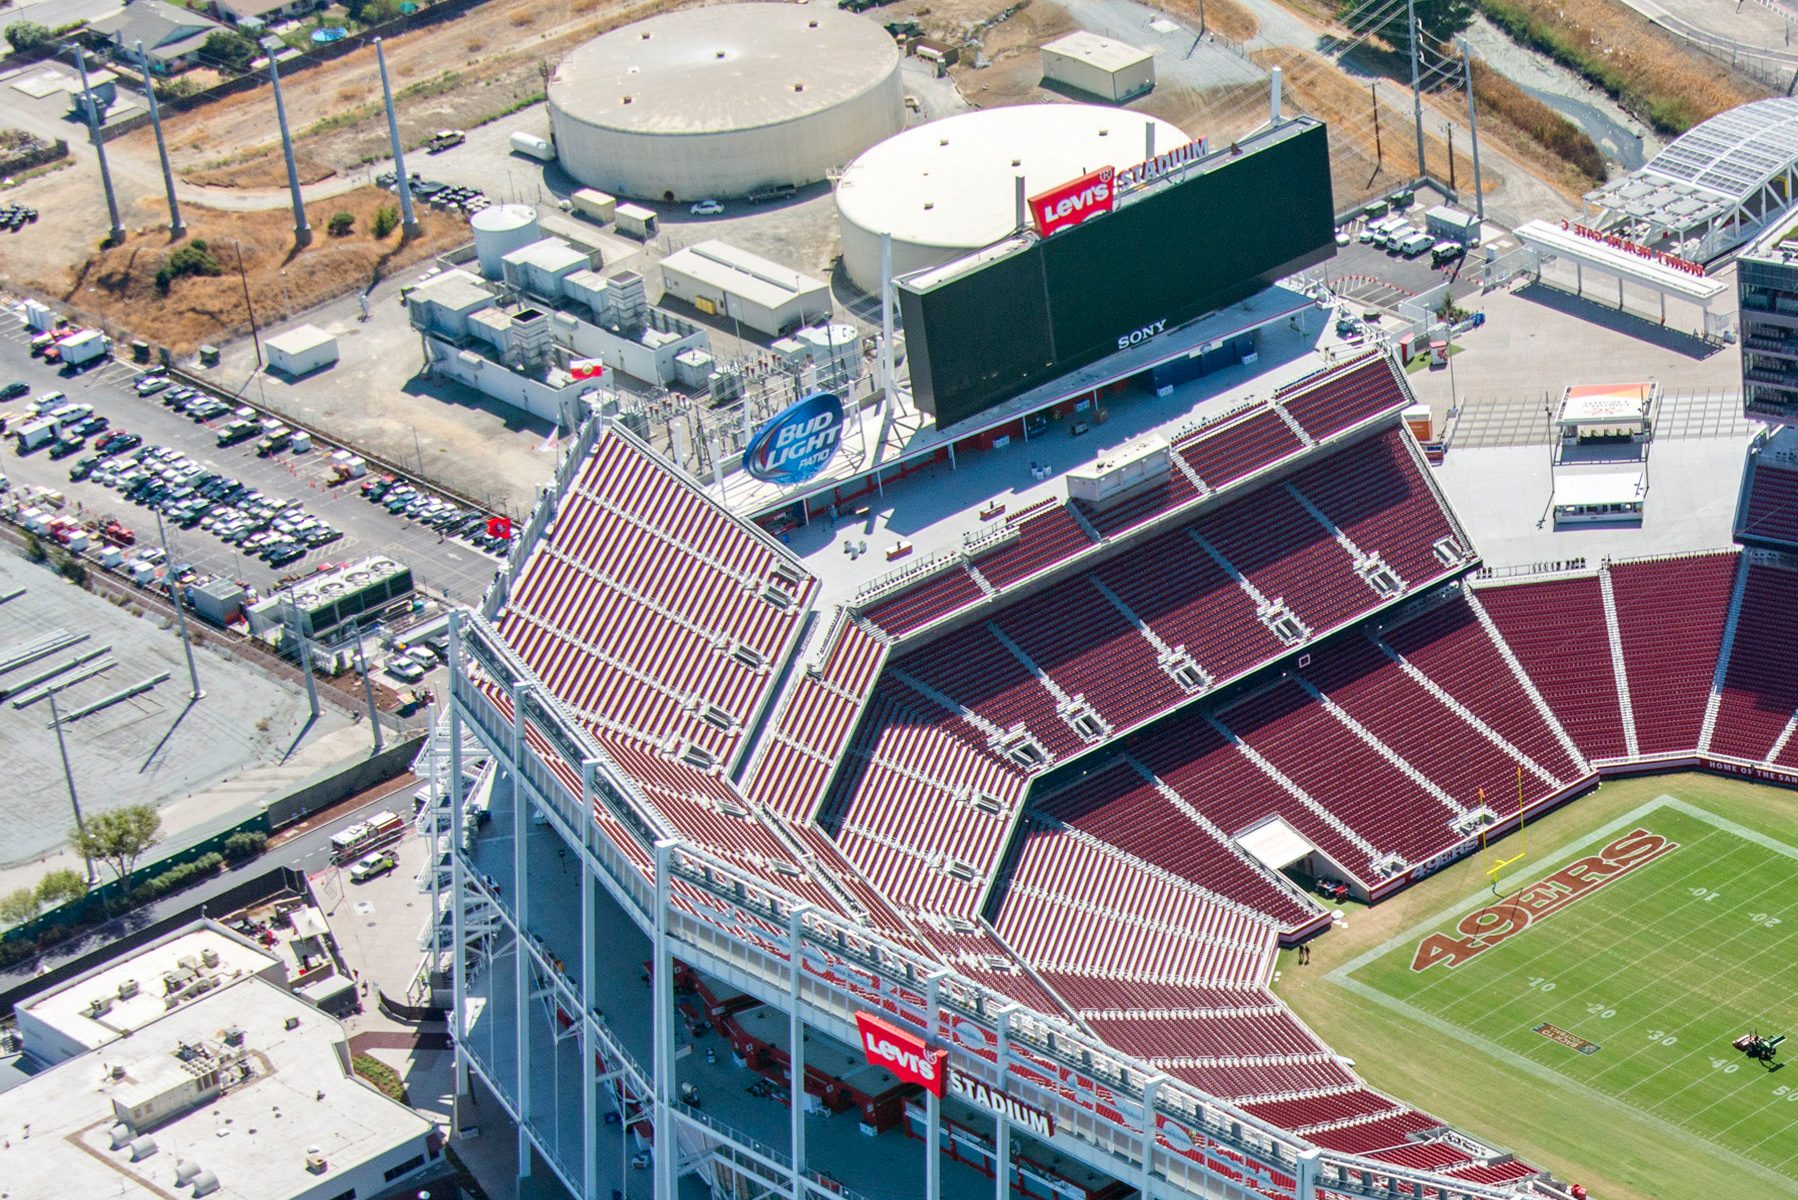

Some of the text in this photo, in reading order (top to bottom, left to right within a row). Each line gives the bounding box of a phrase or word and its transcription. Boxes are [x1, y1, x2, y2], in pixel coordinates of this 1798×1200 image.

[1117, 136, 1209, 189] STADIUM
[1118, 319, 1167, 349] SONY
[776, 412, 834, 449] BUD
[764, 424, 843, 472] LIGHT
[798, 448, 830, 470] PATIO
[1710, 761, 1737, 773] HOME
[1756, 770, 1775, 780] THE
[1778, 774, 1798, 784] SAN
[1410, 836, 1480, 880] 49ERS
[1409, 828, 1681, 974] 49ERS
[1692, 887, 1720, 901] 10
[1752, 912, 1783, 928] 20
[1531, 976, 1556, 992] 10
[1587, 1003, 1617, 1019] 20
[1648, 1029, 1678, 1046] 30
[1712, 1057, 1740, 1074] 40
[951, 1071, 1051, 1137] STADIUM
